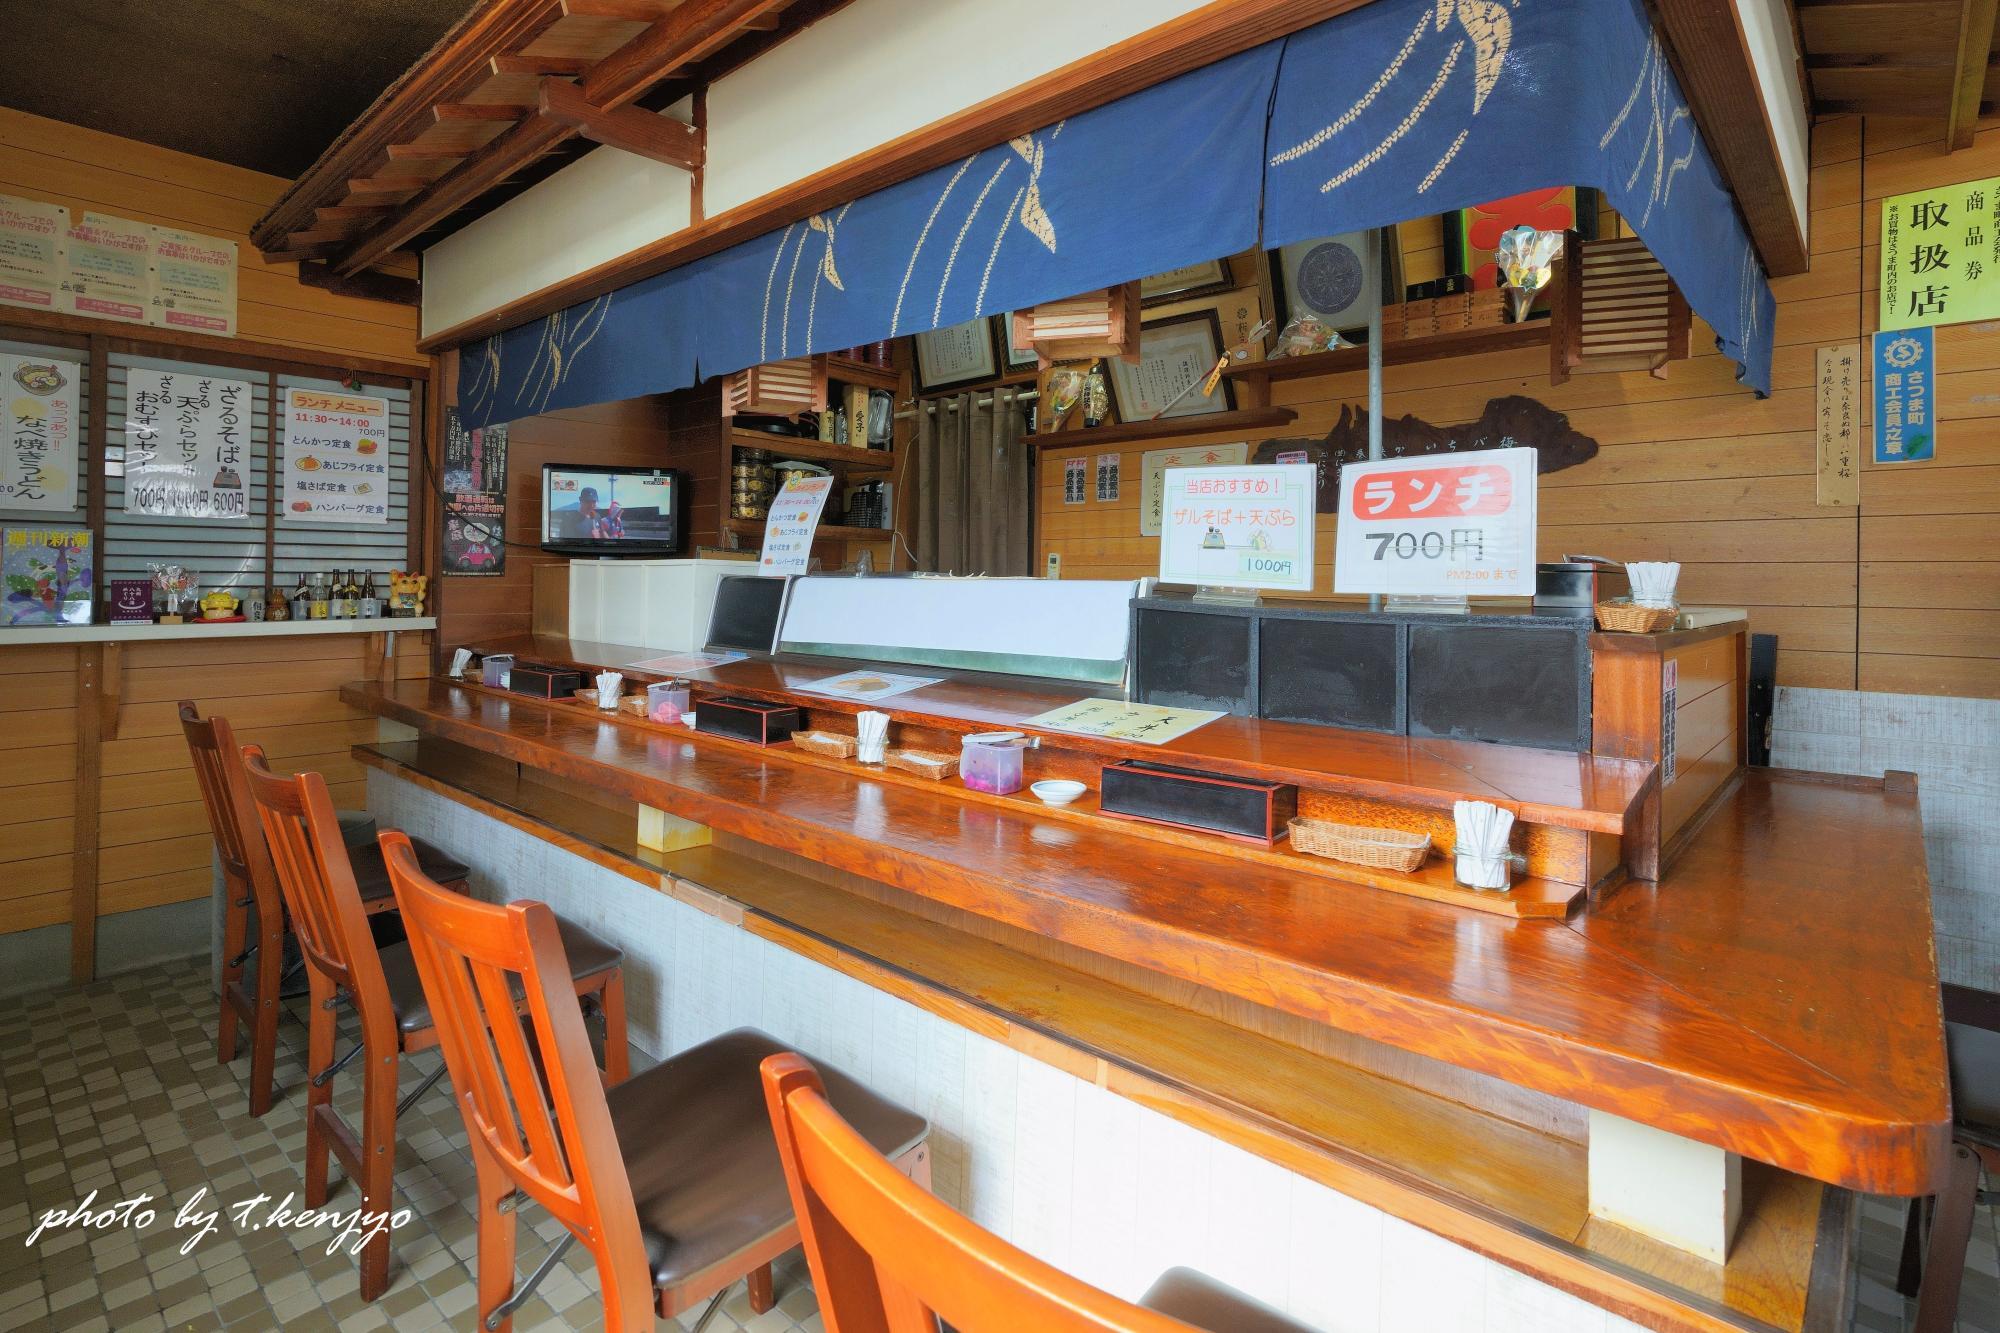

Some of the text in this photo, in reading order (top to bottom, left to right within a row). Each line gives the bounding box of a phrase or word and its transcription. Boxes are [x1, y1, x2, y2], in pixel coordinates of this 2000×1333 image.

[1964, 189, 1984, 281] 商品券
[1908, 199, 1950, 318] 取扱店
[160, 375, 174, 404] ざる
[199, 379, 212, 409] ざる
[1907, 371, 1926, 426] さつま町
[296, 396, 379, 413] ランチ メニュー
[1884, 372, 1904, 455] 商工会員之章
[217, 385, 242, 464] ざるそば
[295, 412, 370, 428] 11:30～14:00
[292, 435, 352, 449] とんかつ定食
[359, 428, 385, 438] 700円
[14, 415, 48, 500] なべ焼きうどん
[322, 460, 385, 474] あじフライ定食
[296, 481, 347, 493] 塩さば定食
[1187, 478, 1279, 494] 当店おすすめ！
[1364, 473, 1497, 514] ランチ
[213, 492, 244, 514] 600円
[315, 503, 385, 514] ハンバーグ定食
[8, 530, 90, 548] 週刊新潮
[1365, 527, 1484, 562] 700円
[1246, 557, 1292, 575] 1000円
[1446, 568, 1519, 581] PM2:00 まで
